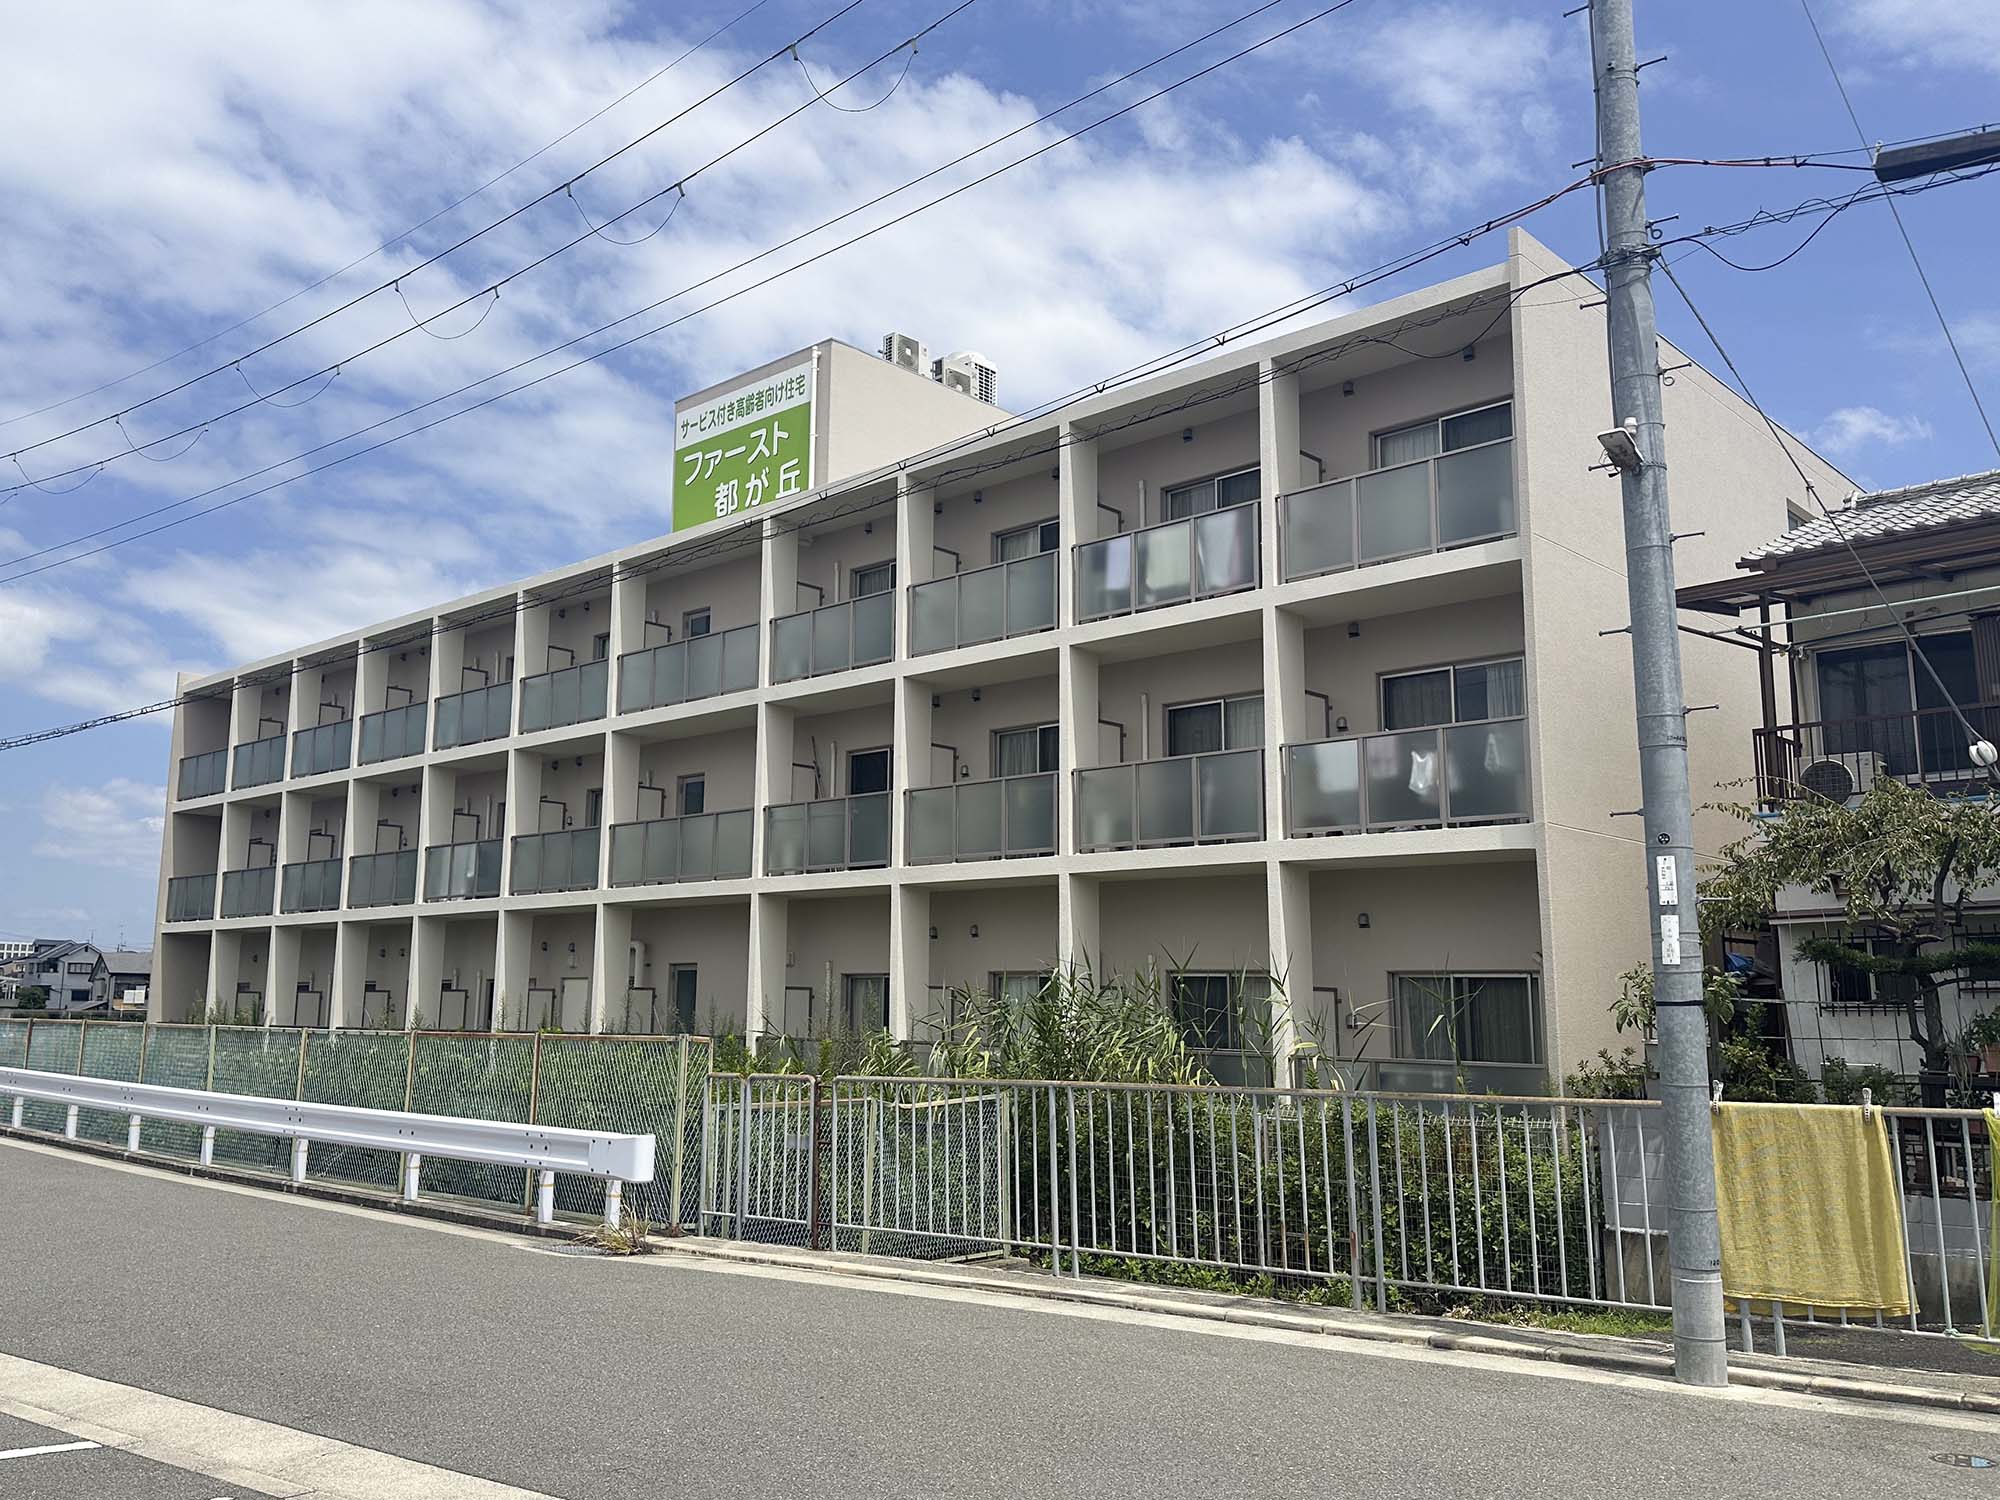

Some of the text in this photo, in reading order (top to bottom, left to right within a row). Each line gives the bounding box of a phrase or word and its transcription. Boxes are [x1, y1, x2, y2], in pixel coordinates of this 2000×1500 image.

[681, 373, 806, 439] サービス付き高齢者向け住宅
[683, 420, 789, 486] ファースト
[714, 458, 801, 518] 都が丘
